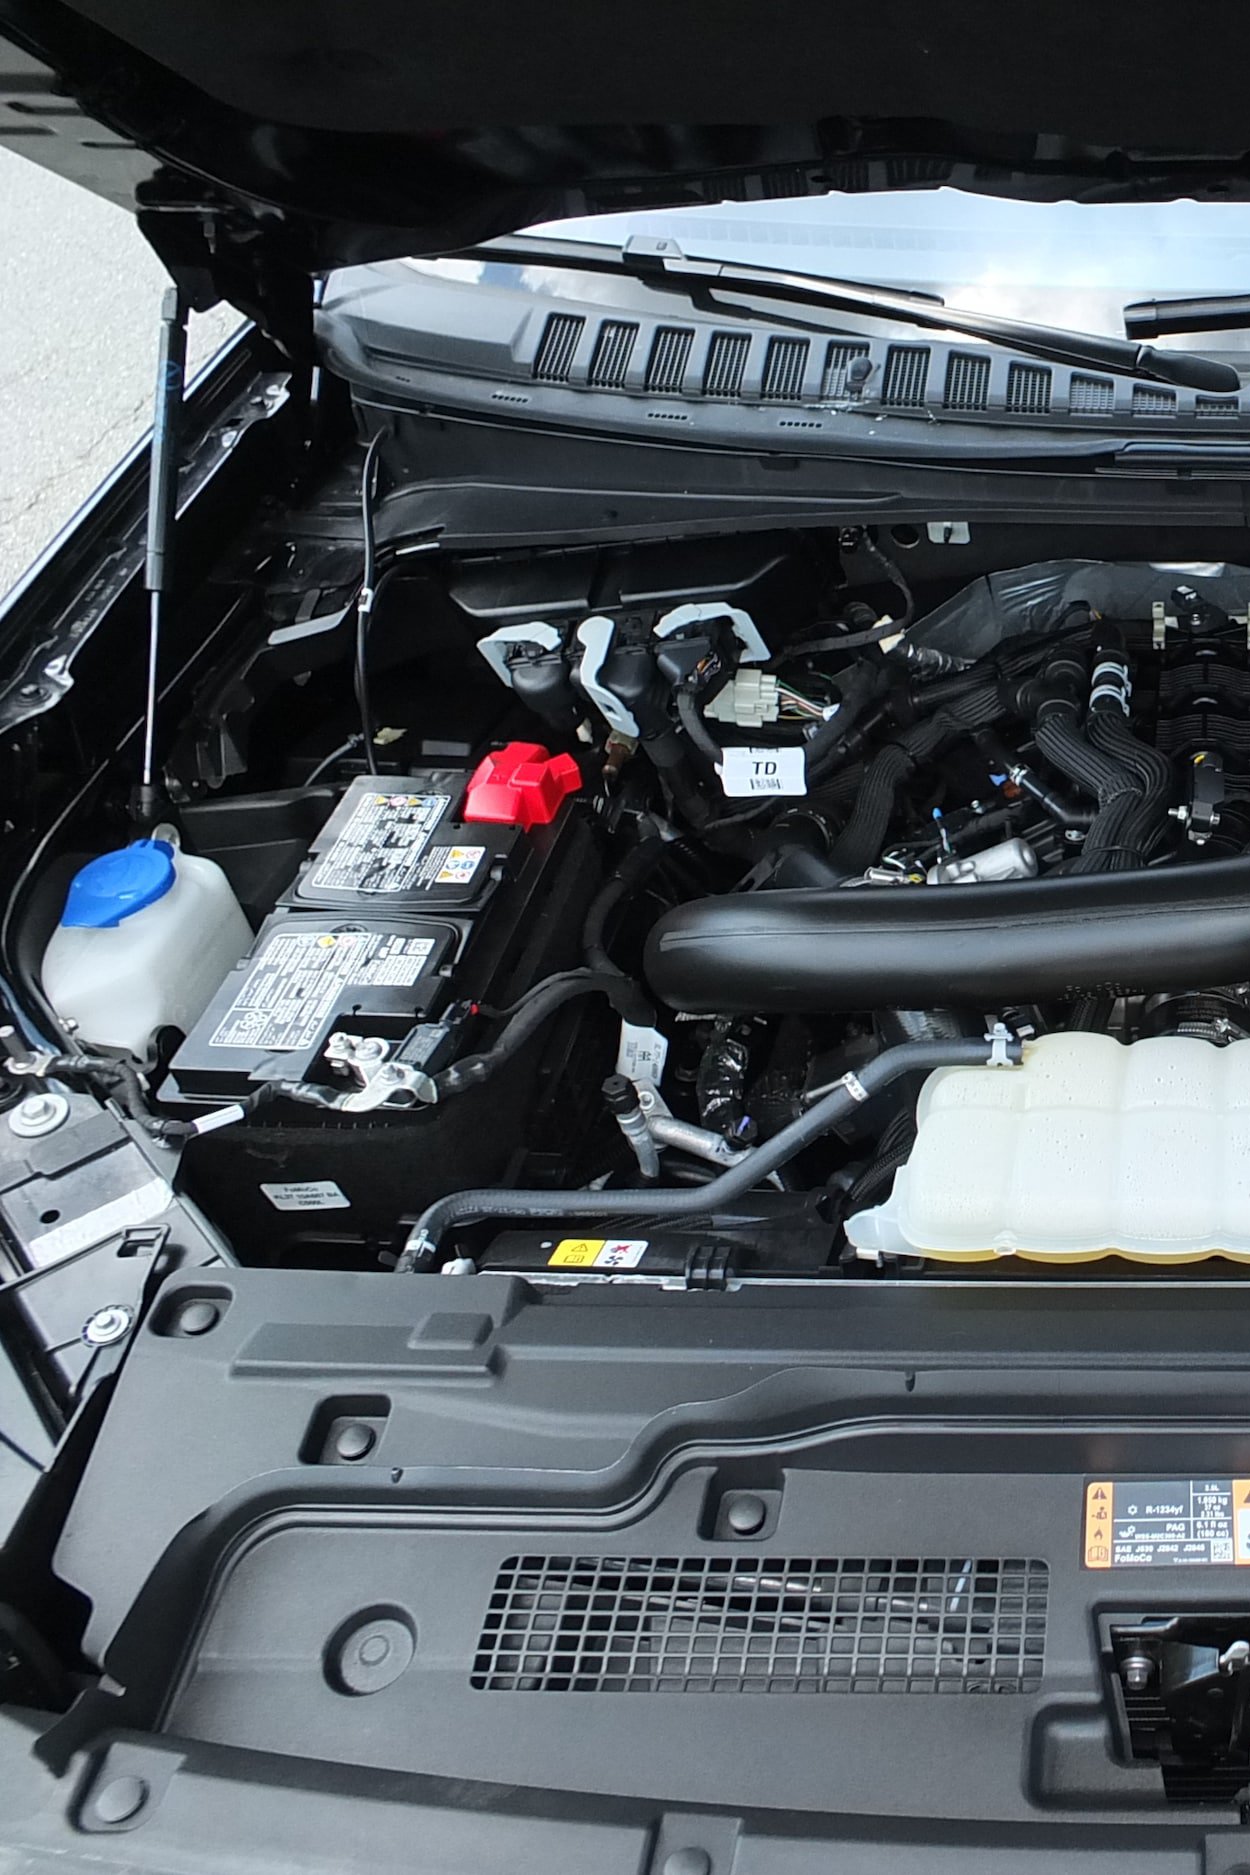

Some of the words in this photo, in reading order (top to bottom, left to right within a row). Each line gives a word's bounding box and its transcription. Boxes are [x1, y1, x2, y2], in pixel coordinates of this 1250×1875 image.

[752, 761, 777, 775] TD
[1145, 1505, 1184, 1515] R-1234yf
[1166, 1523, 1186, 1531] PAG
[1114, 1553, 1152, 1563] FoMoCo
